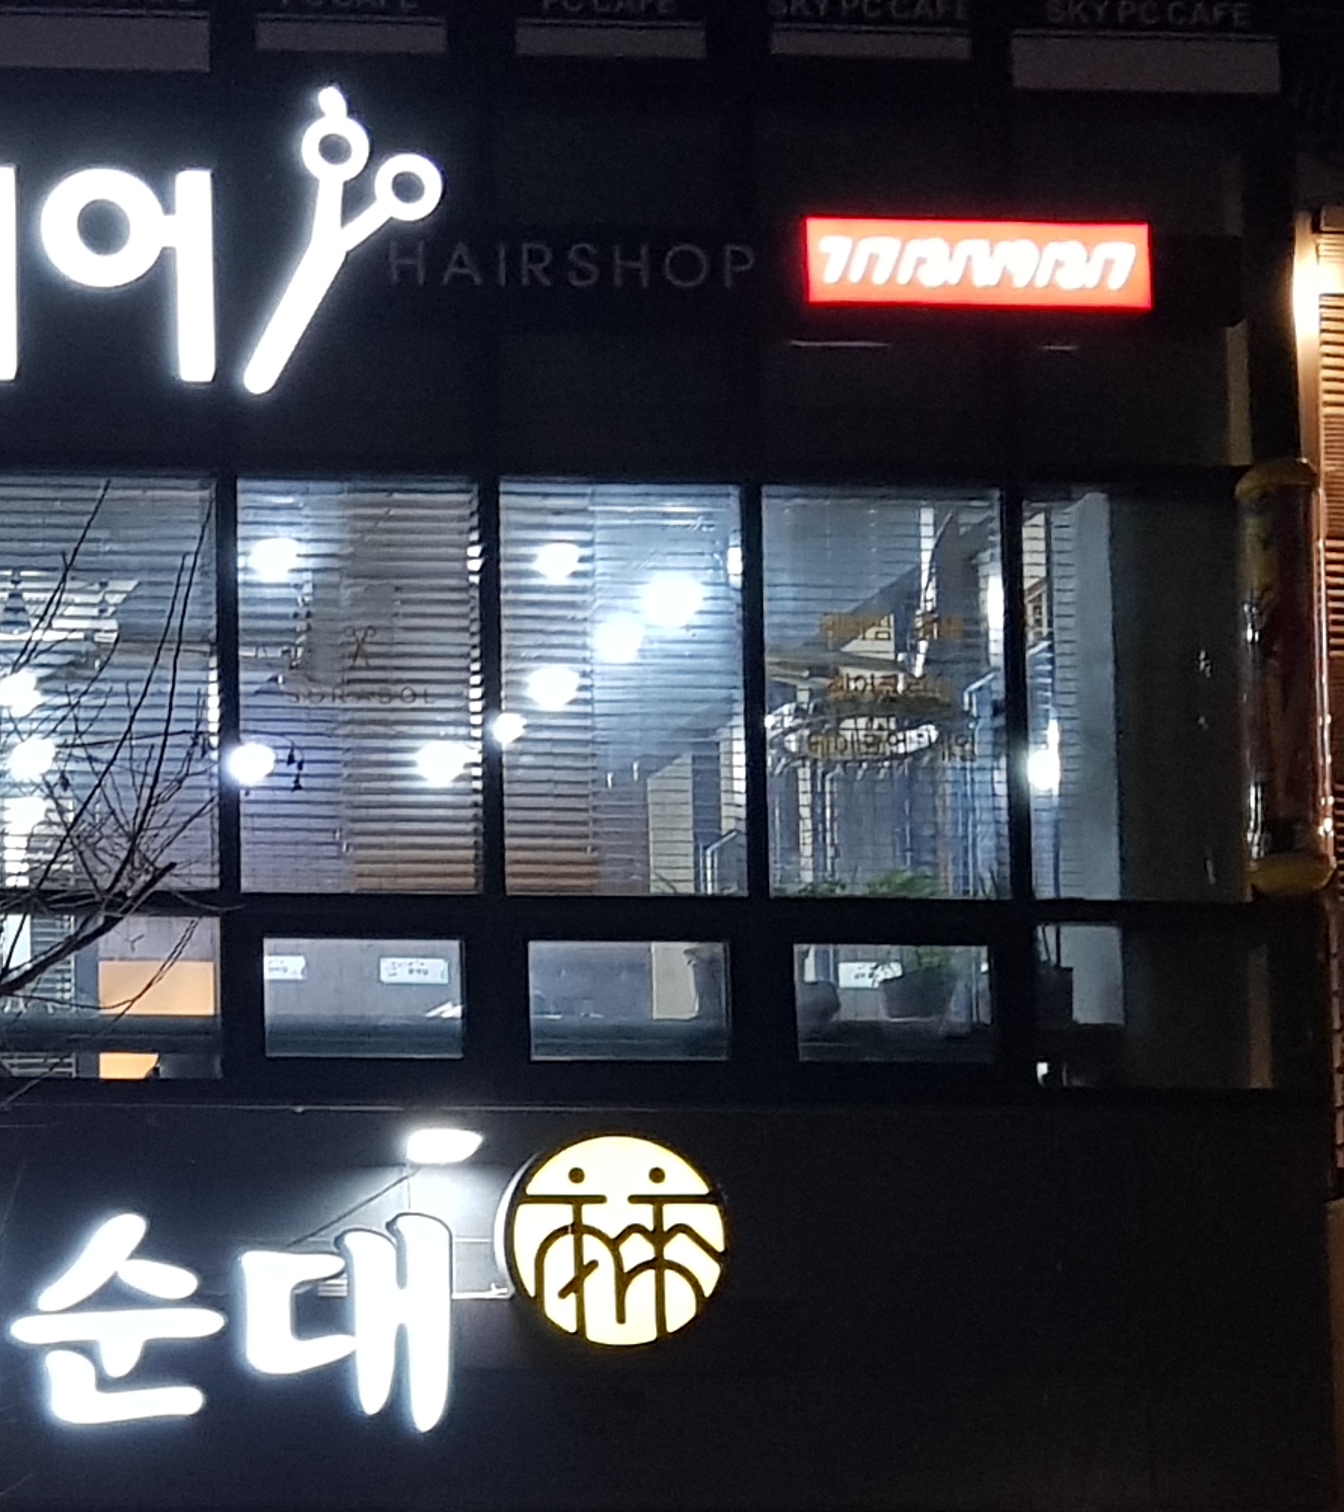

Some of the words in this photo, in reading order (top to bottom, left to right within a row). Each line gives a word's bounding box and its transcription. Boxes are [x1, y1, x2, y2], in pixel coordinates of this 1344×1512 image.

[1046, 0, 1110, 24] SKY
[1117, 0, 1160, 25] PC
[1167, 2, 1251, 27] CAFE
[385, 236, 756, 289] HAIRSHOP
